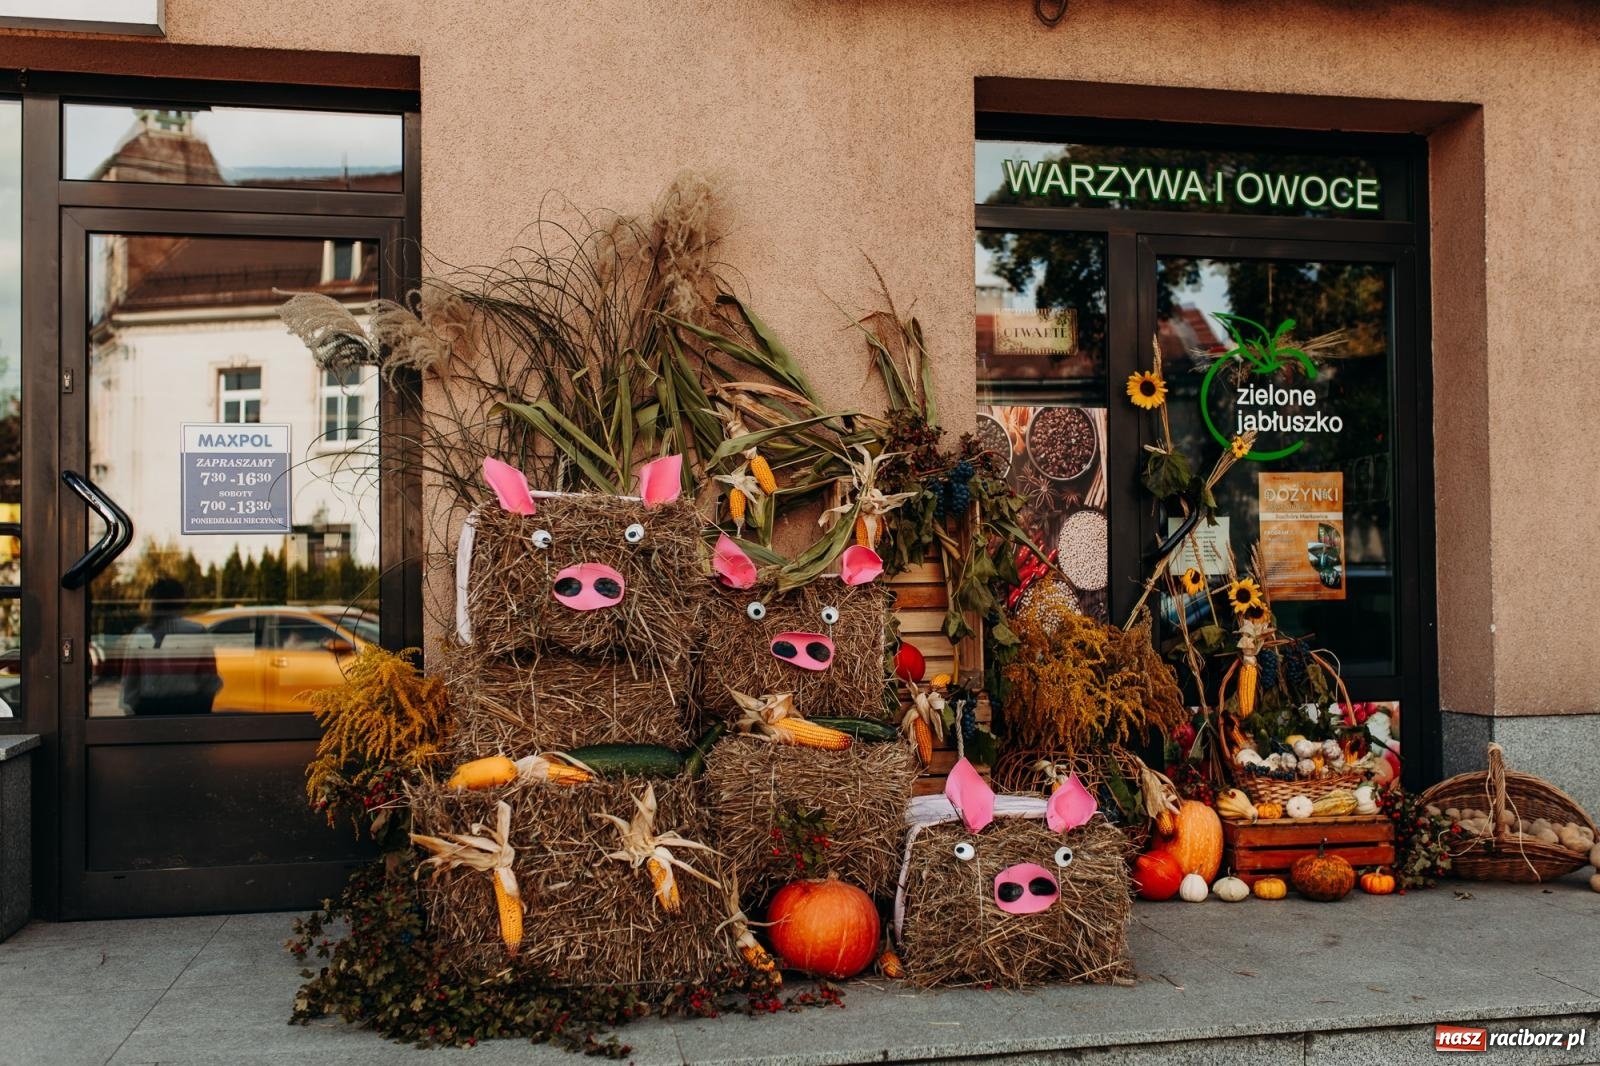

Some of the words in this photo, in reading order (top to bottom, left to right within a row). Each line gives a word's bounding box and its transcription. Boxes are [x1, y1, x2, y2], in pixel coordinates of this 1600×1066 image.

[1004, 159, 1207, 202] WARZYWA
[1214, 171, 1224, 203] I
[1235, 171, 1380, 211] OWOCE
[1236, 383, 1317, 406] zielone
[1236, 409, 1343, 435] jabłuszko
[198, 433, 272, 448] MAXPOL
[196, 458, 276, 468] ZAPRASZAMY
